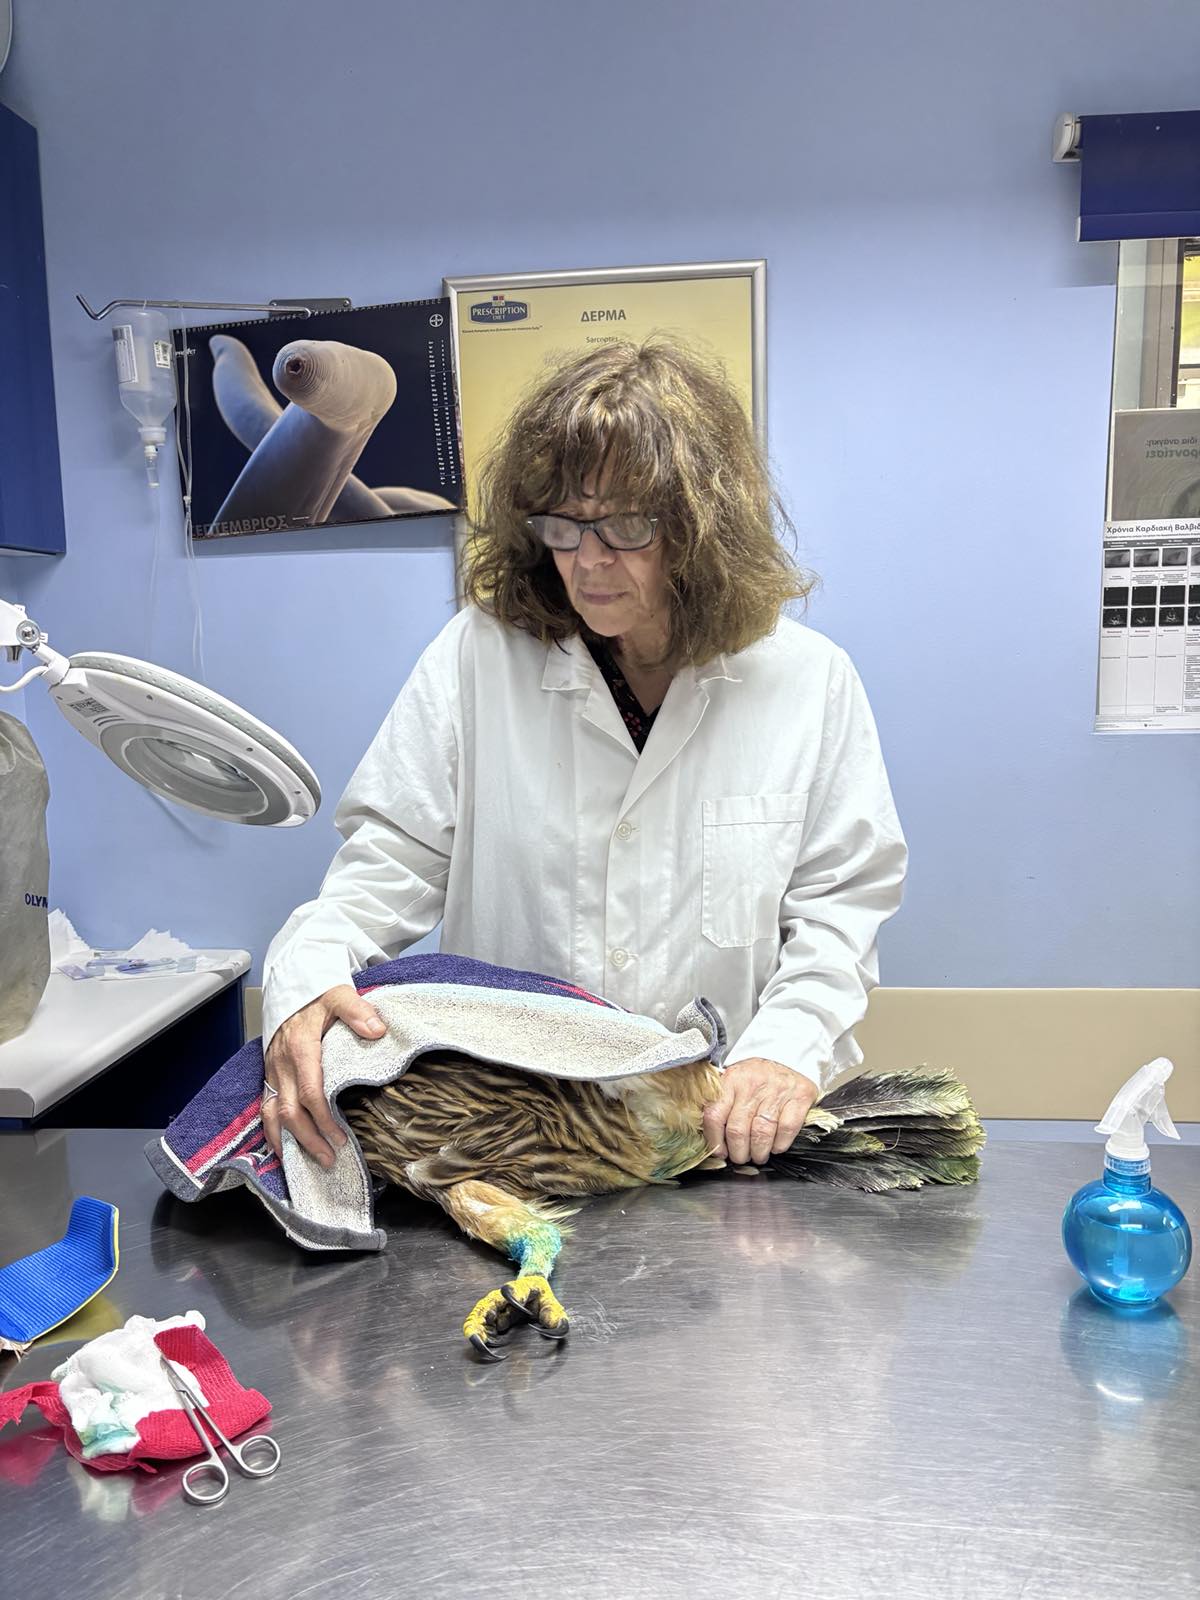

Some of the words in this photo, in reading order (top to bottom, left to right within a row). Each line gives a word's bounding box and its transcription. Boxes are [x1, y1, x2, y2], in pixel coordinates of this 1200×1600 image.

[472, 306, 526, 317] PRESCRIPTION
[580, 309, 627, 322] ΔΕΡΜΑ
[1106, 525, 1134, 534] Χρόνια
[1135, 524, 1173, 533] Καρδιακή
